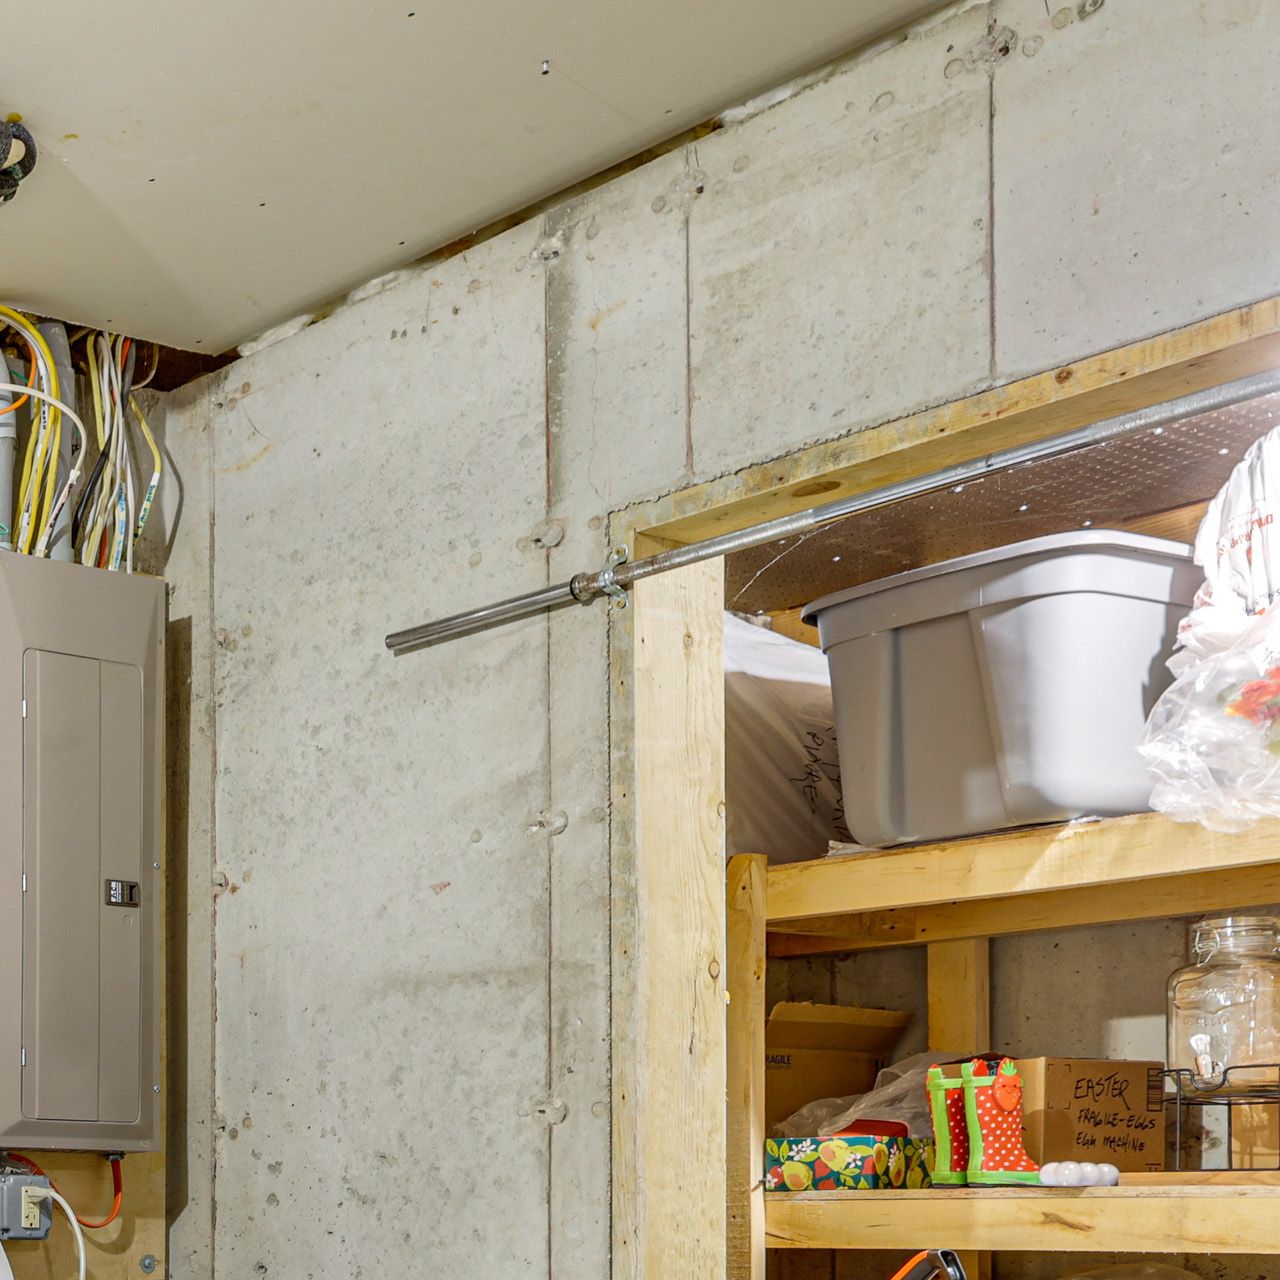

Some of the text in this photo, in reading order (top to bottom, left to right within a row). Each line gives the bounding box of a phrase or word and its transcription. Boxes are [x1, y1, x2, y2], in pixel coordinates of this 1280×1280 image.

[765, 1054, 792, 1065] RAGILE
[1074, 1071, 1132, 1110] EASTER
[1103, 1133, 1146, 1153] MACHINE
